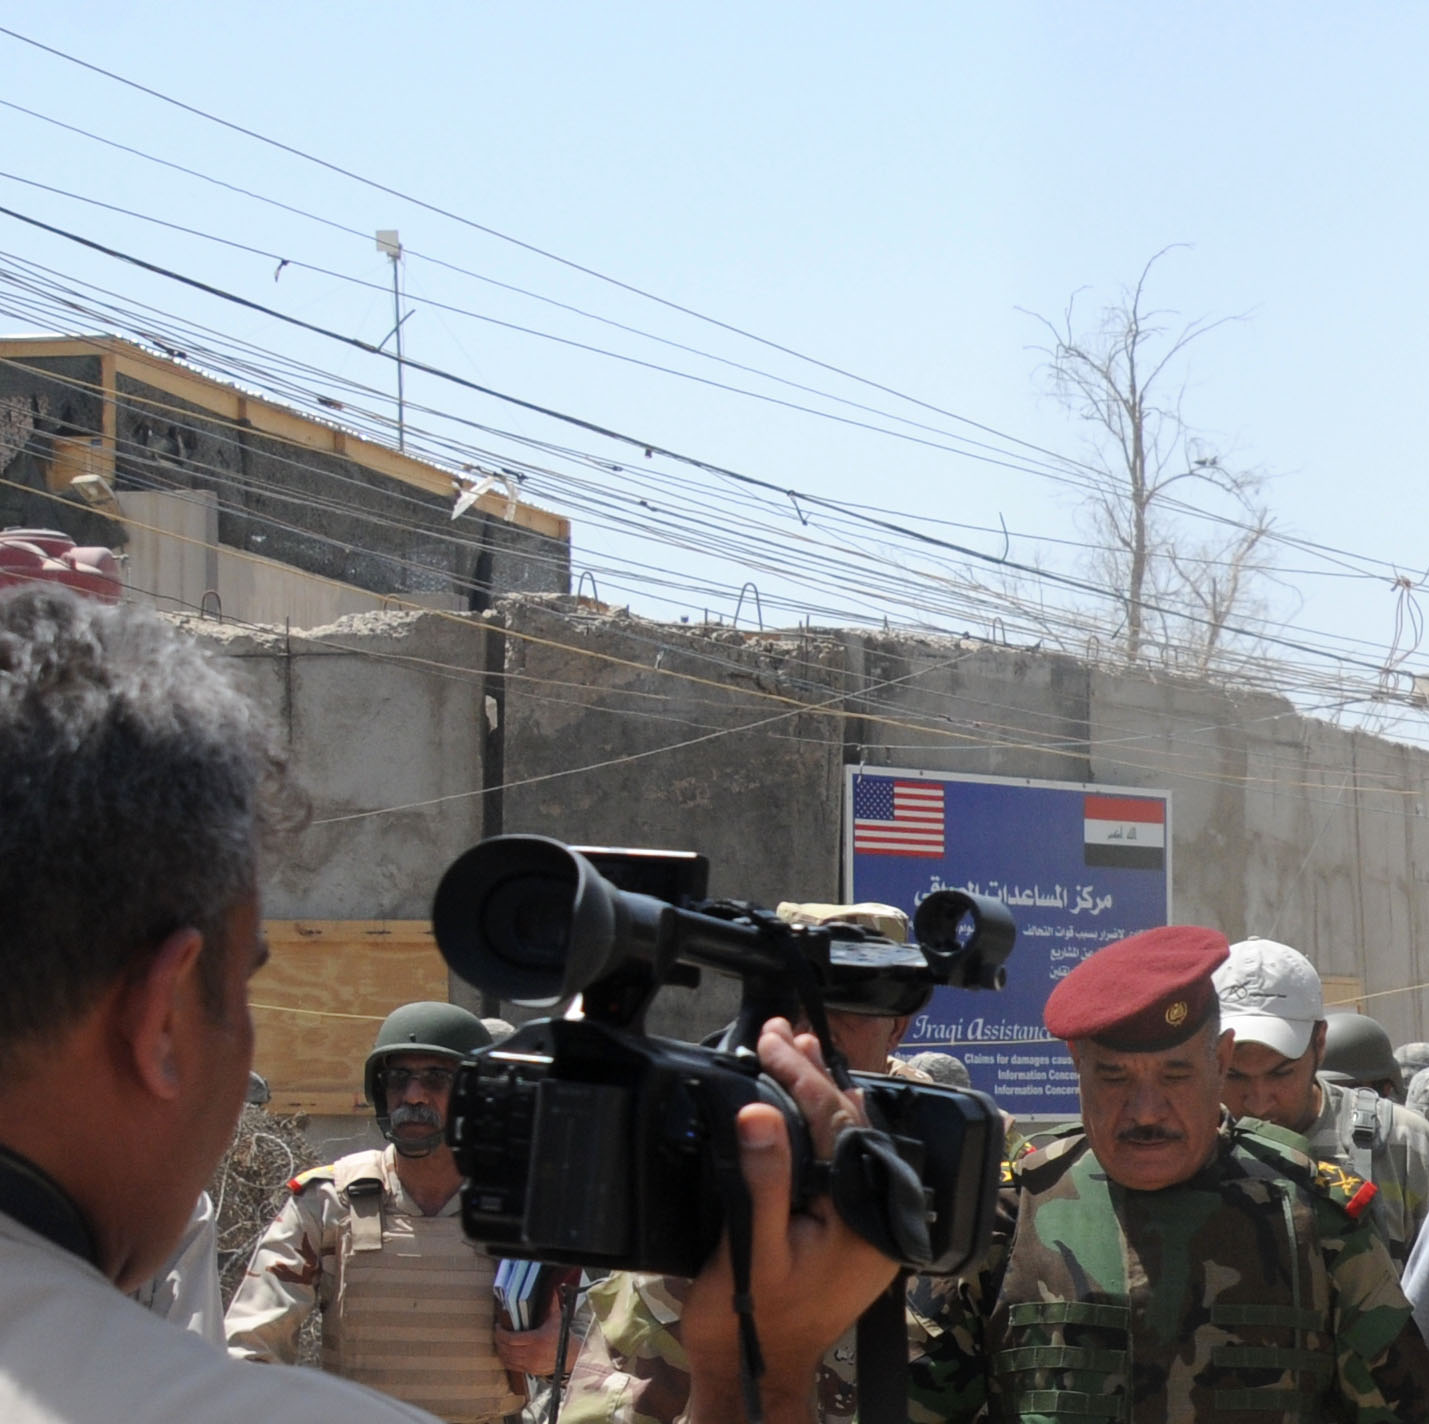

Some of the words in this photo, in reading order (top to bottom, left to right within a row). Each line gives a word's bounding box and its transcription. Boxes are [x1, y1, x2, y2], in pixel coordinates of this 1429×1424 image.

[1070, 884, 1112, 915] مركز
[913, 1015, 964, 1047] Iraqi
[967, 1018, 1051, 1042] Assistanc
[964, 1053, 994, 1065] Claims
[996, 1052, 1009, 1064] for
[1011, 1053, 1049, 1067] damages
[1051, 1056, 1073, 1065] caus
[998, 1069, 1047, 1080] Information
[994, 1084, 1043, 1096] Information
